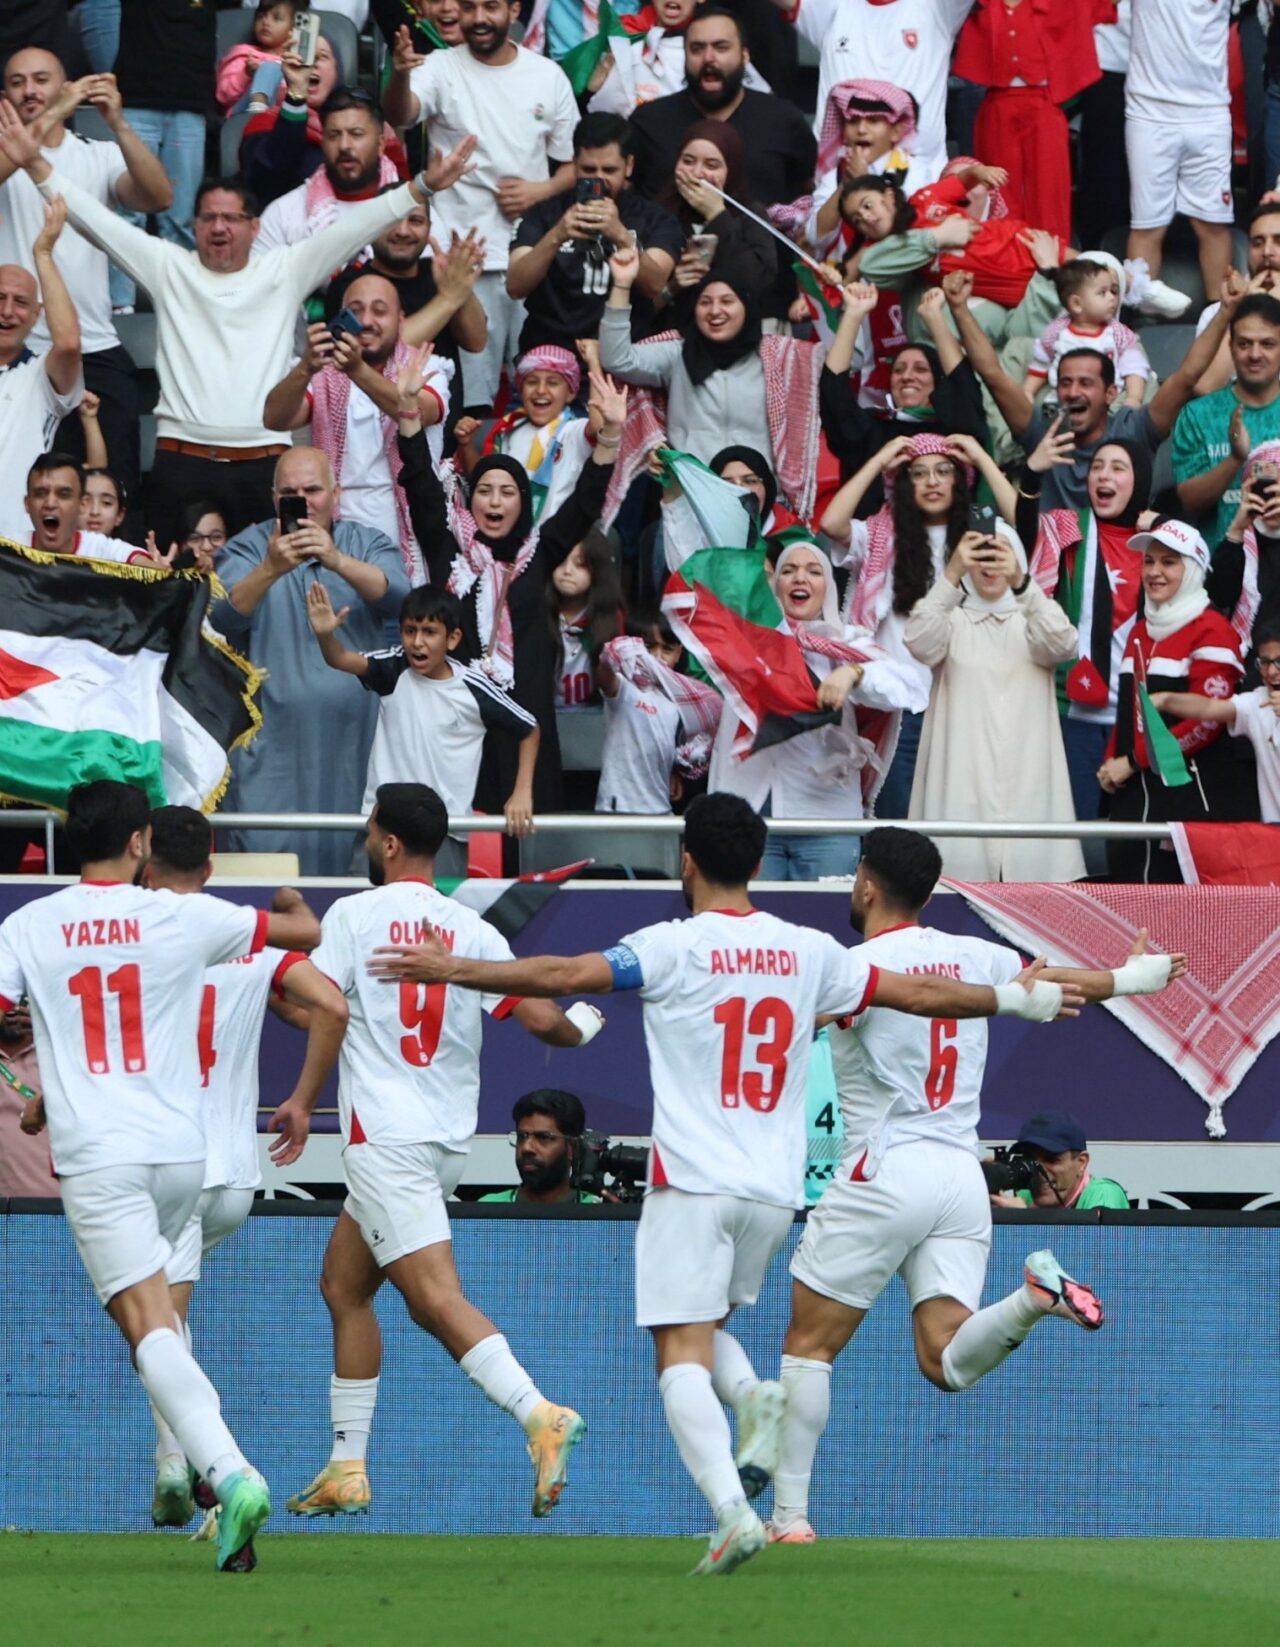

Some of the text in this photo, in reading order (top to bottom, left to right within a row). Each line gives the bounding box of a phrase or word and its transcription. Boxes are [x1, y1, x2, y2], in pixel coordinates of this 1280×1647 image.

[561, 672, 592, 705] 10
[61, 918, 140, 948] YAZAN
[710, 948, 798, 977] ALMARDI
[68, 963, 147, 1074] 11
[399, 981, 448, 1069] 9
[713, 996, 795, 1113] 13
[924, 1017, 959, 1113] 6
[814, 1101, 841, 1135] 4
